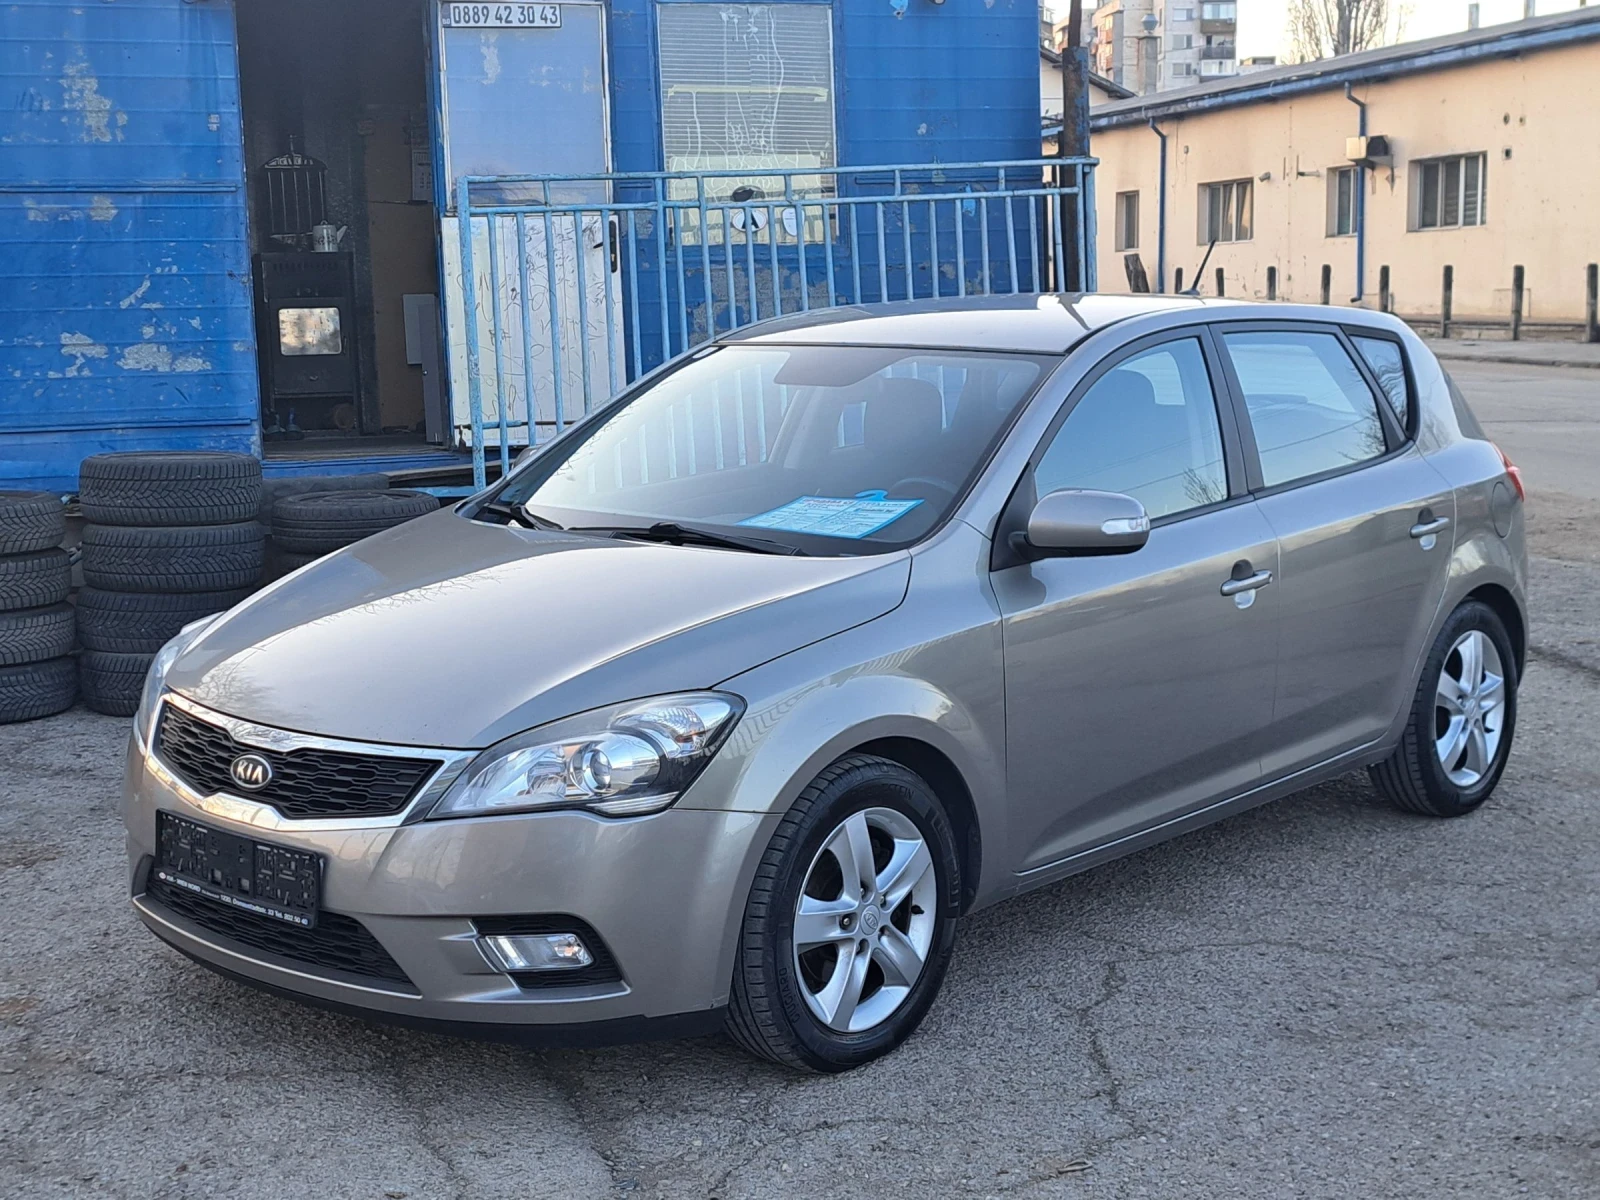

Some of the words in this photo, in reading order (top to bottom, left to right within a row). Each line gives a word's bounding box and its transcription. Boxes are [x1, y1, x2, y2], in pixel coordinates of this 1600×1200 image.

[452, 5, 490, 24] 0889
[494, 5, 513, 24] 42
[517, 5, 536, 24] 30
[539, 5, 558, 24] 43
[236, 759, 263, 784] KIA
